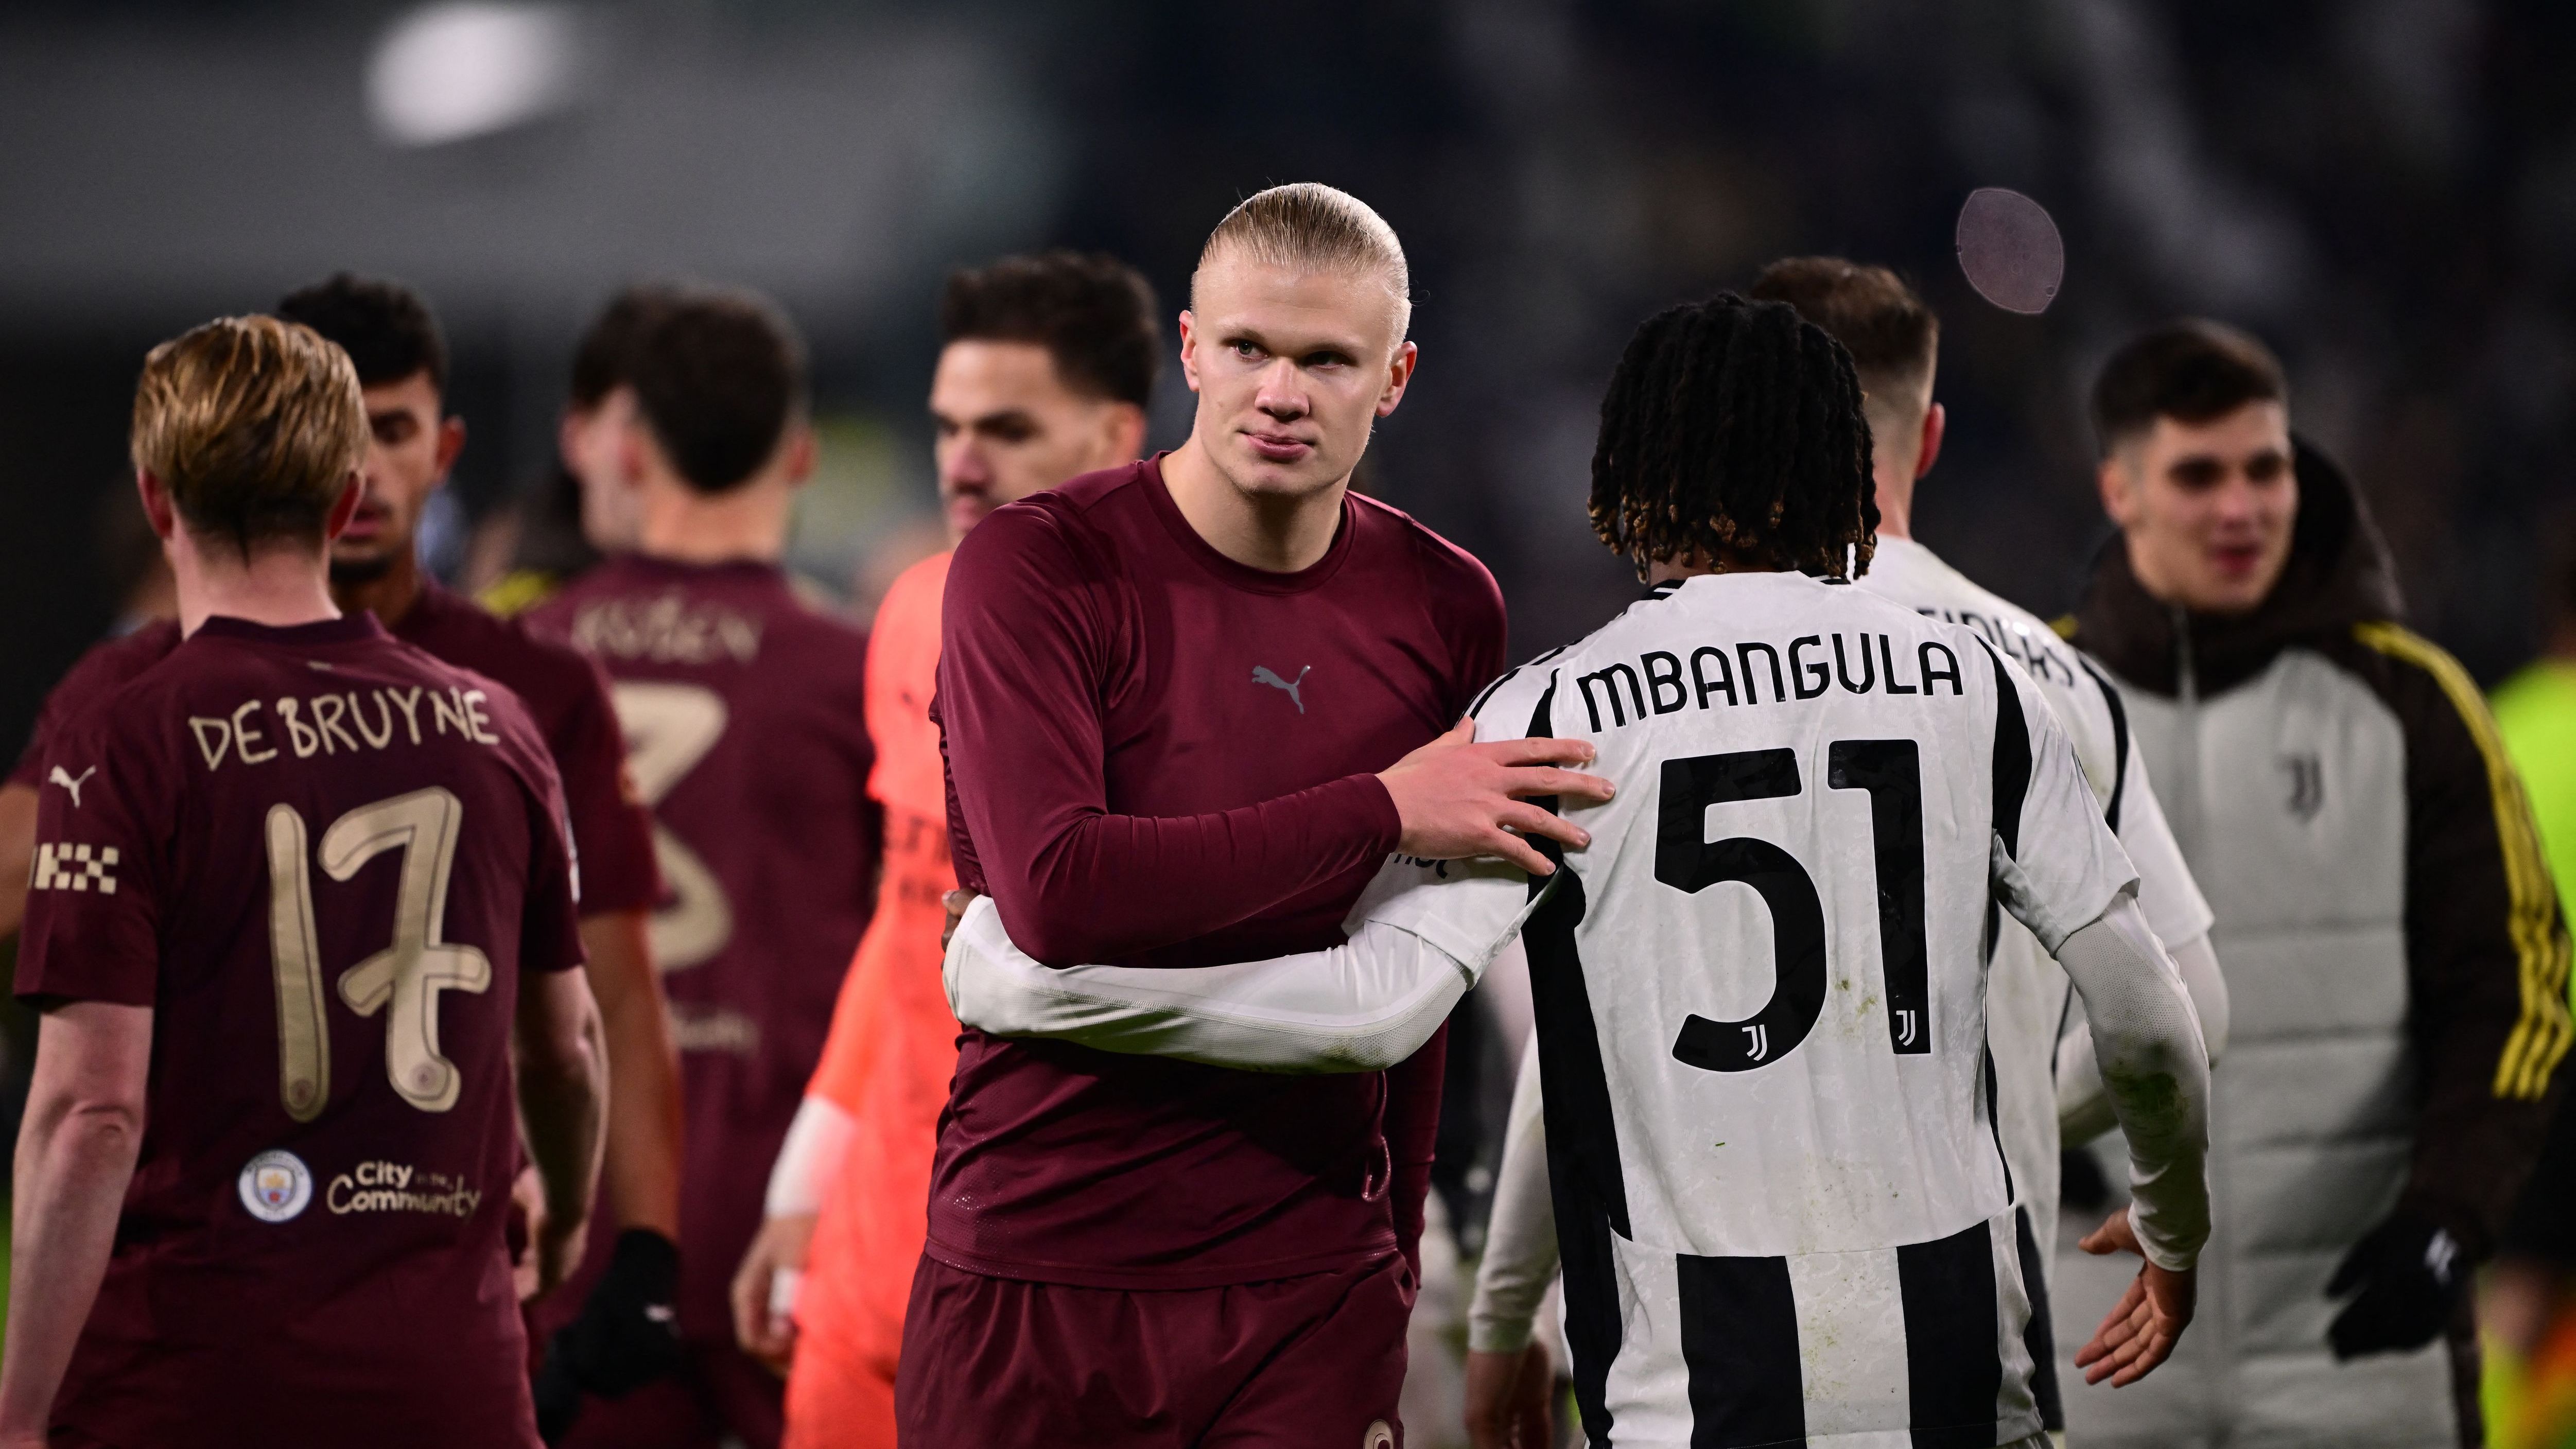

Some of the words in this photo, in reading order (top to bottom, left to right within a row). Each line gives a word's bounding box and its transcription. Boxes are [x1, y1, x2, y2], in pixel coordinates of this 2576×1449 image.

[188, 700, 278, 771] DE
[276, 686, 500, 759] BRUYNE
[1576, 632, 1963, 733] MBANGULA
[1653, 739, 1931, 1073] 51
[265, 785, 492, 1123] 17
[326, 1173, 482, 1223] Community
[355, 1160, 414, 1190] City
